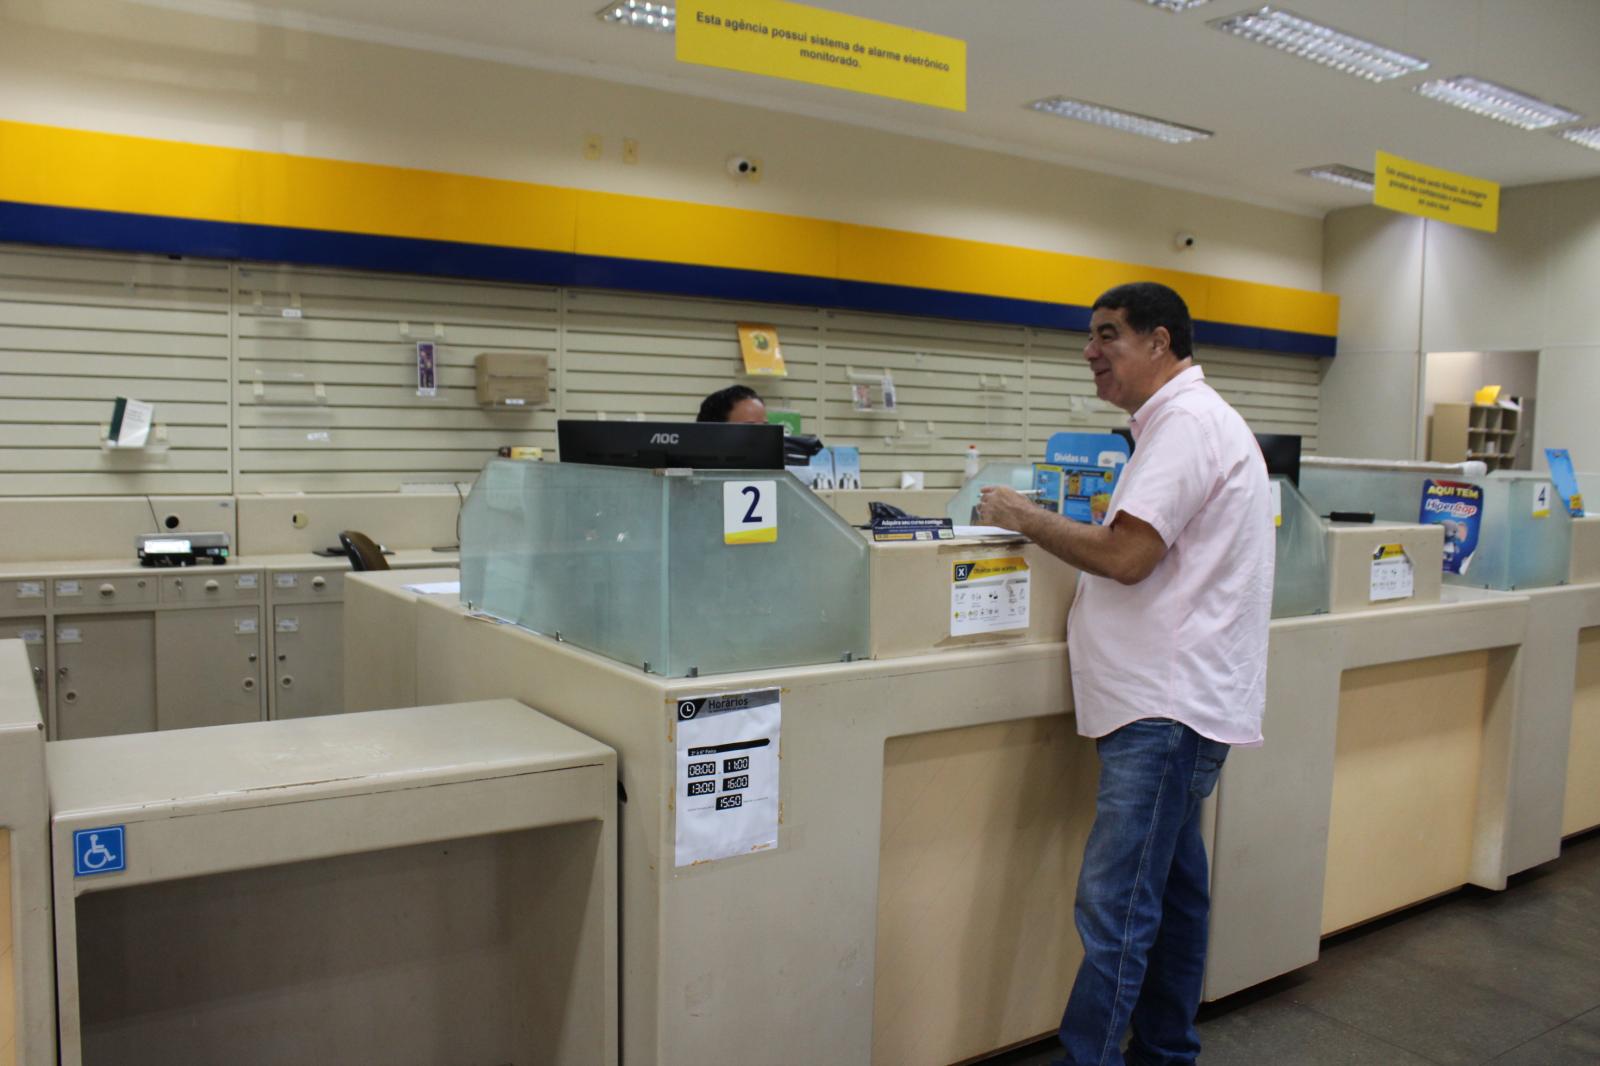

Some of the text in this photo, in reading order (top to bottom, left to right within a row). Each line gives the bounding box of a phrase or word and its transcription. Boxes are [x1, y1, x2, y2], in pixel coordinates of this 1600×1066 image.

[696, 11, 950, 72] Esta agência possui sistema de alarme eletrônico
[800, 48, 861, 68] monitorado.
[650, 433, 680, 445] AOC
[1427, 485, 1479, 499] AQUI TEM
[1537, 485, 1547, 506] 4
[741, 486, 763, 523] 2
[689, 758, 749, 776] 08:00 11:00
[692, 776, 748, 794] 13:00 16:00
[720, 795, 741, 808] 15:50
